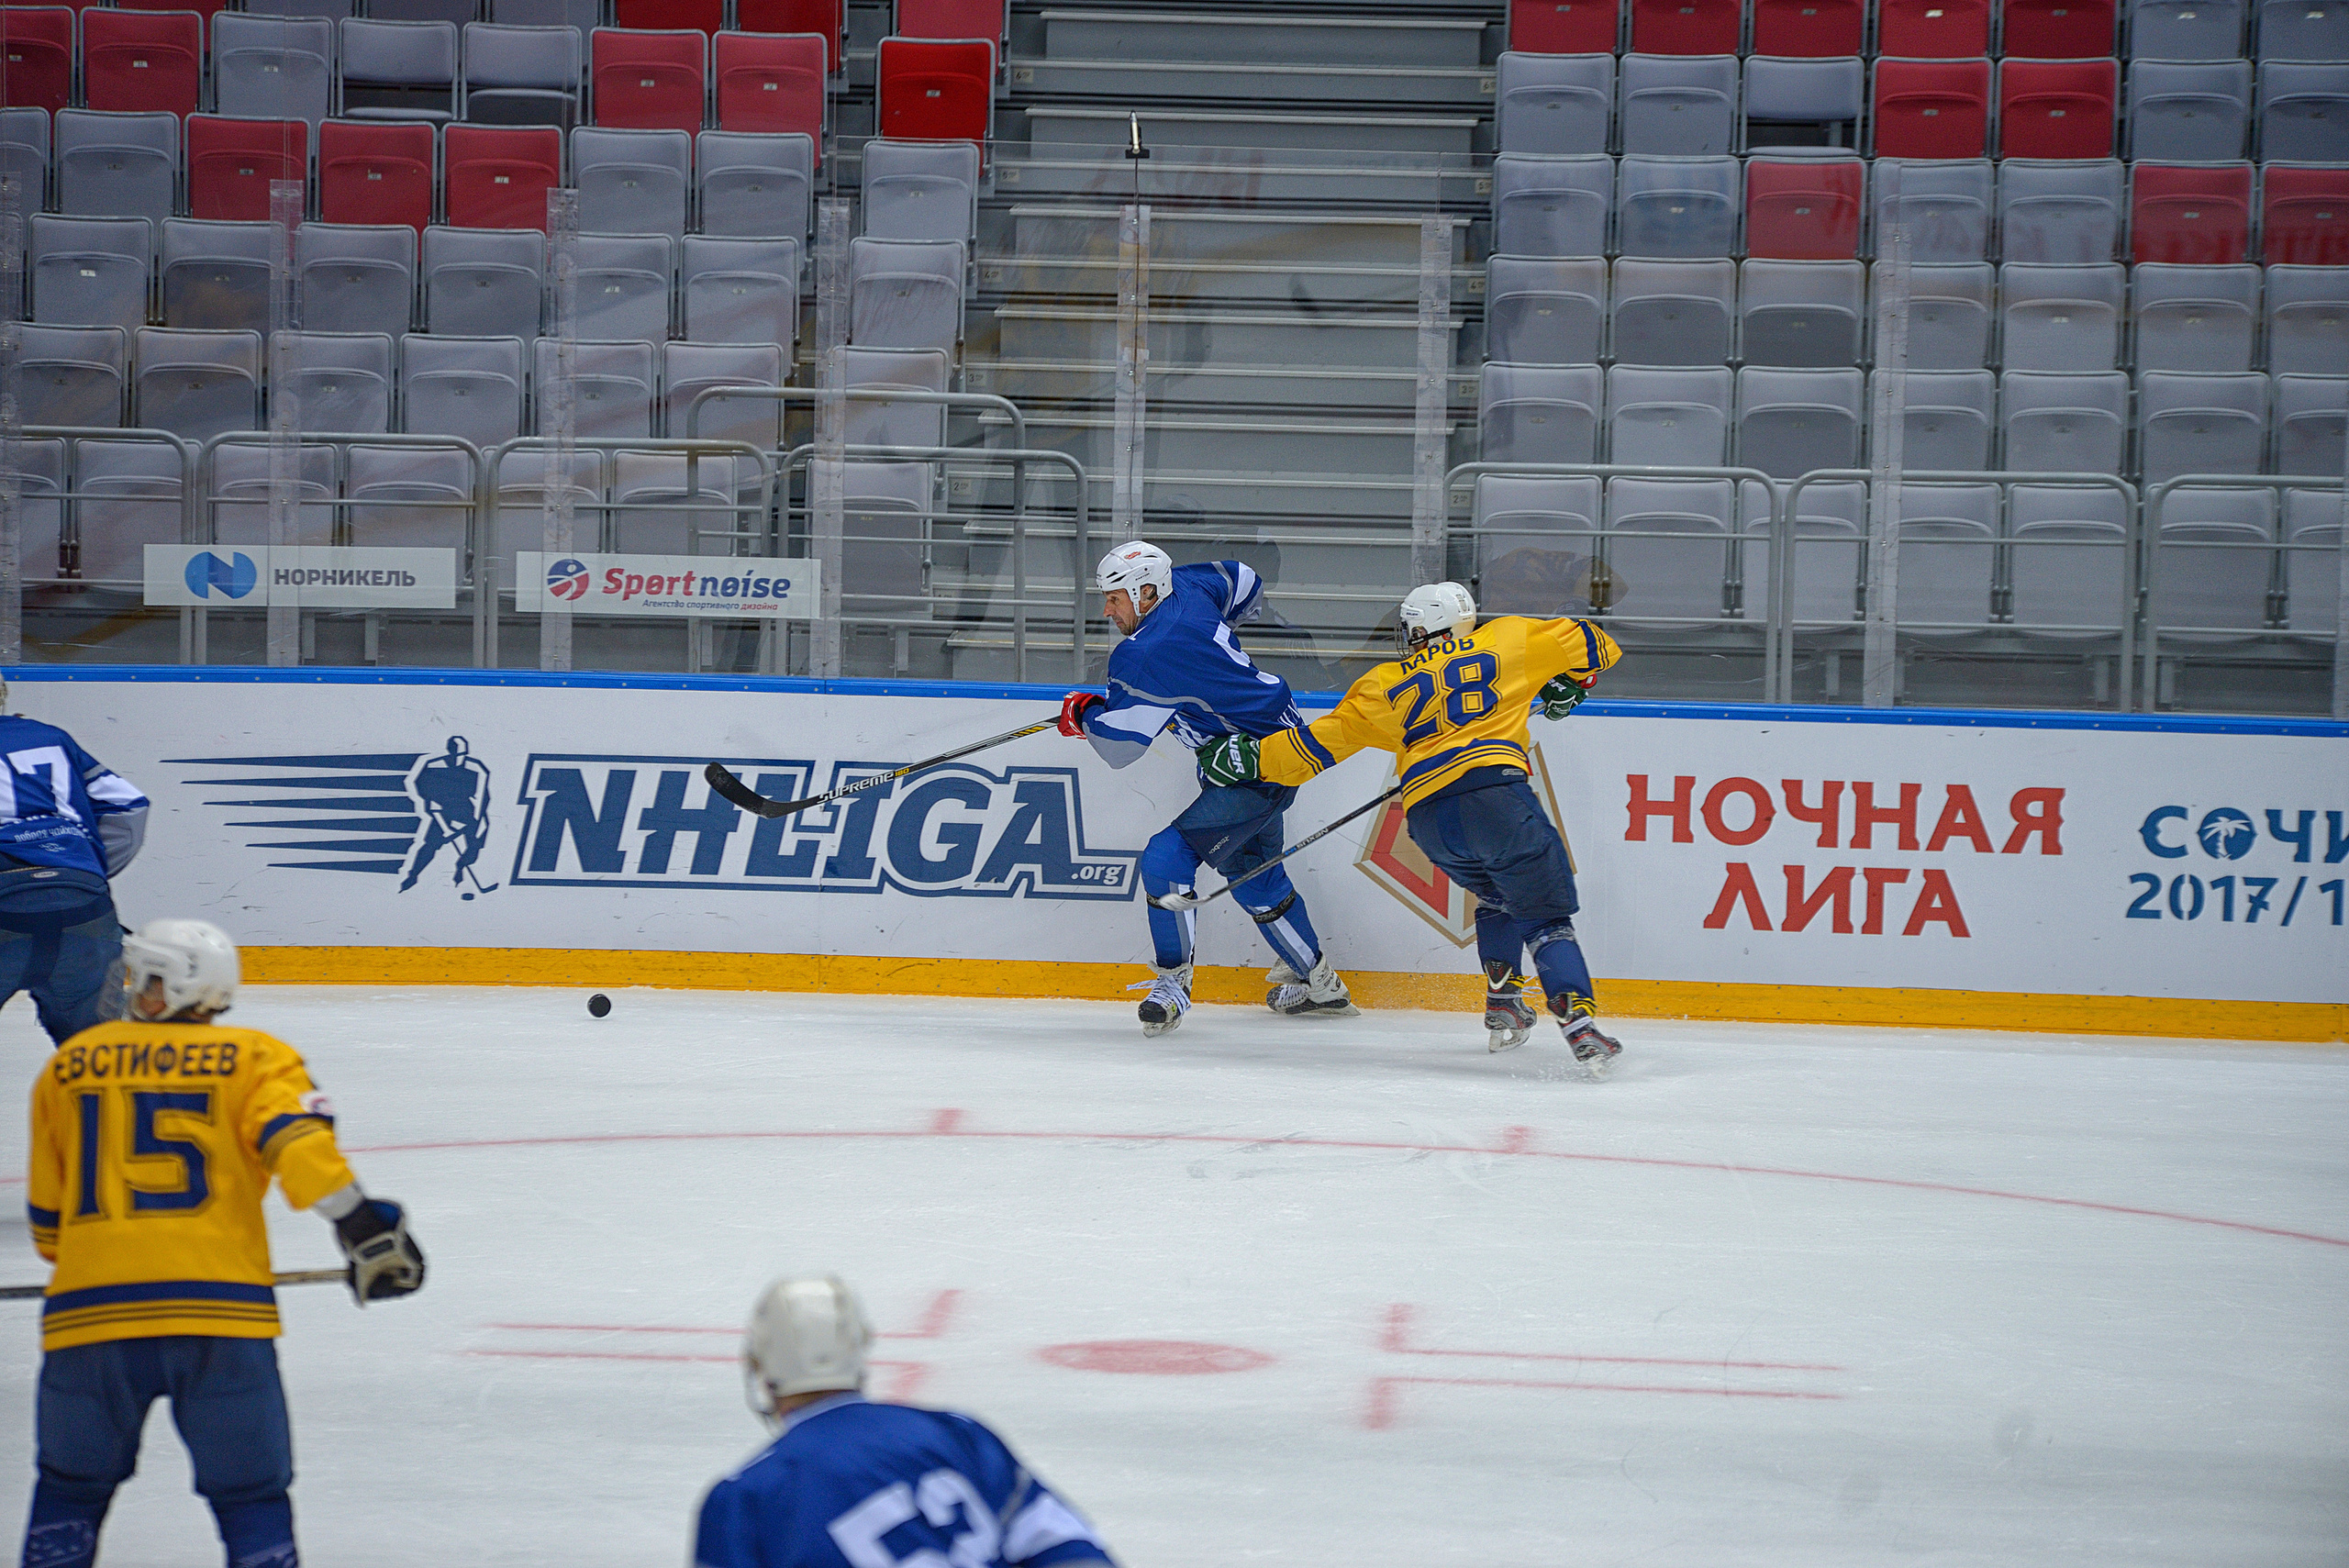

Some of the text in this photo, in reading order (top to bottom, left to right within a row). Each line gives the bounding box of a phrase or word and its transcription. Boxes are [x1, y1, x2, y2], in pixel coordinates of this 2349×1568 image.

[274, 569, 416, 587] НОРНИКЕЛЬ
[686, 600, 739, 612] спортивного
[740, 601, 778, 611] дизайна
[1384, 650, 1503, 752] 28
[1229, 733, 1246, 774] UER
[818, 767, 909, 804] SUPREME 180
[1624, 773, 2066, 855] НОЧНАЯ
[1703, 862, 1972, 938] ЛИГА
[54, 1042, 239, 1084] ЕВСТИФЕЕВ
[68, 1085, 217, 1226] 15
